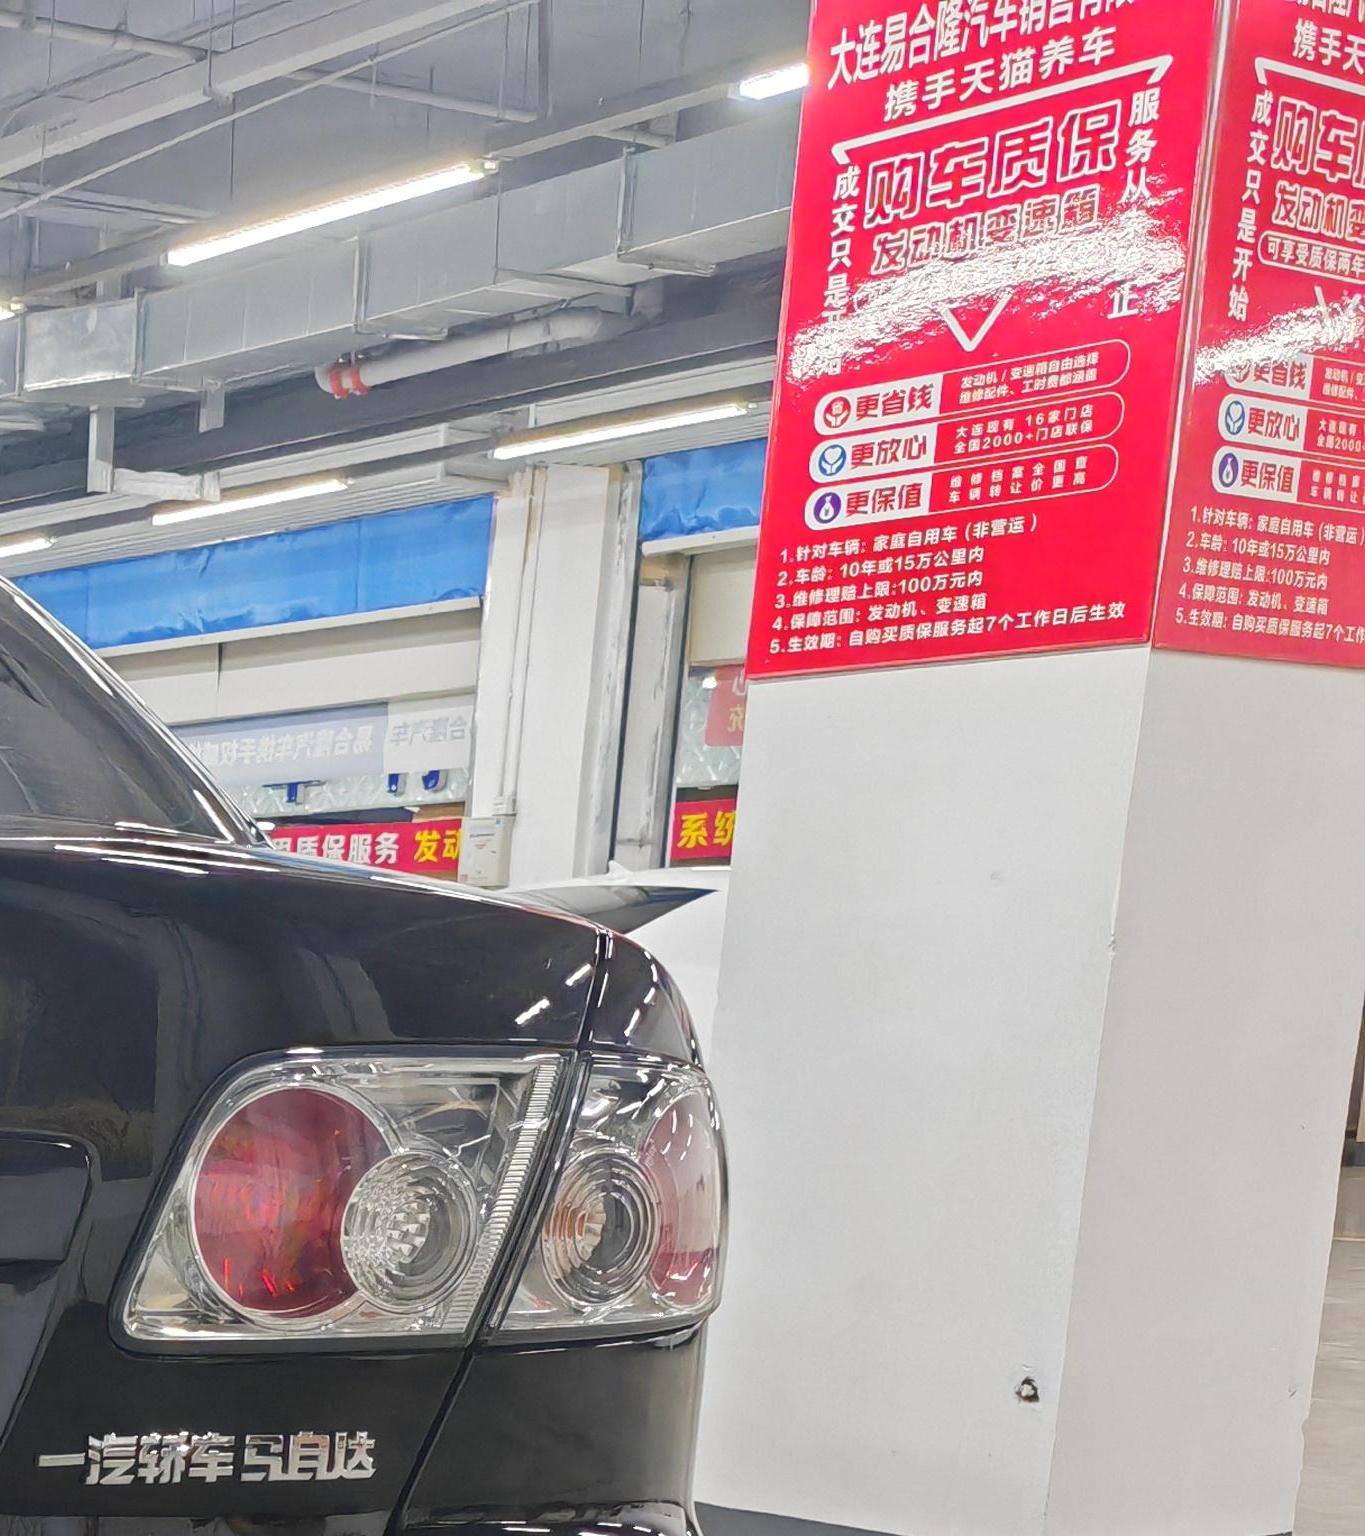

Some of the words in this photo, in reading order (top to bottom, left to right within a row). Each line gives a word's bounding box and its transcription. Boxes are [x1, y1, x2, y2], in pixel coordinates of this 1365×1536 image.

[883, 27, 1117, 121] 携手天猫养车
[1270, 95, 1365, 188] 购车
[864, 99, 1122, 229] 购车质保
[1227, 90, 1273, 322] 成交只是开始
[855, 383, 934, 420] 更省钱
[1247, 406, 1300, 441] 更放心
[850, 435, 928, 470] 更放心
[1240, 459, 1295, 493] 更保值
[845, 482, 925, 517] 更保值
